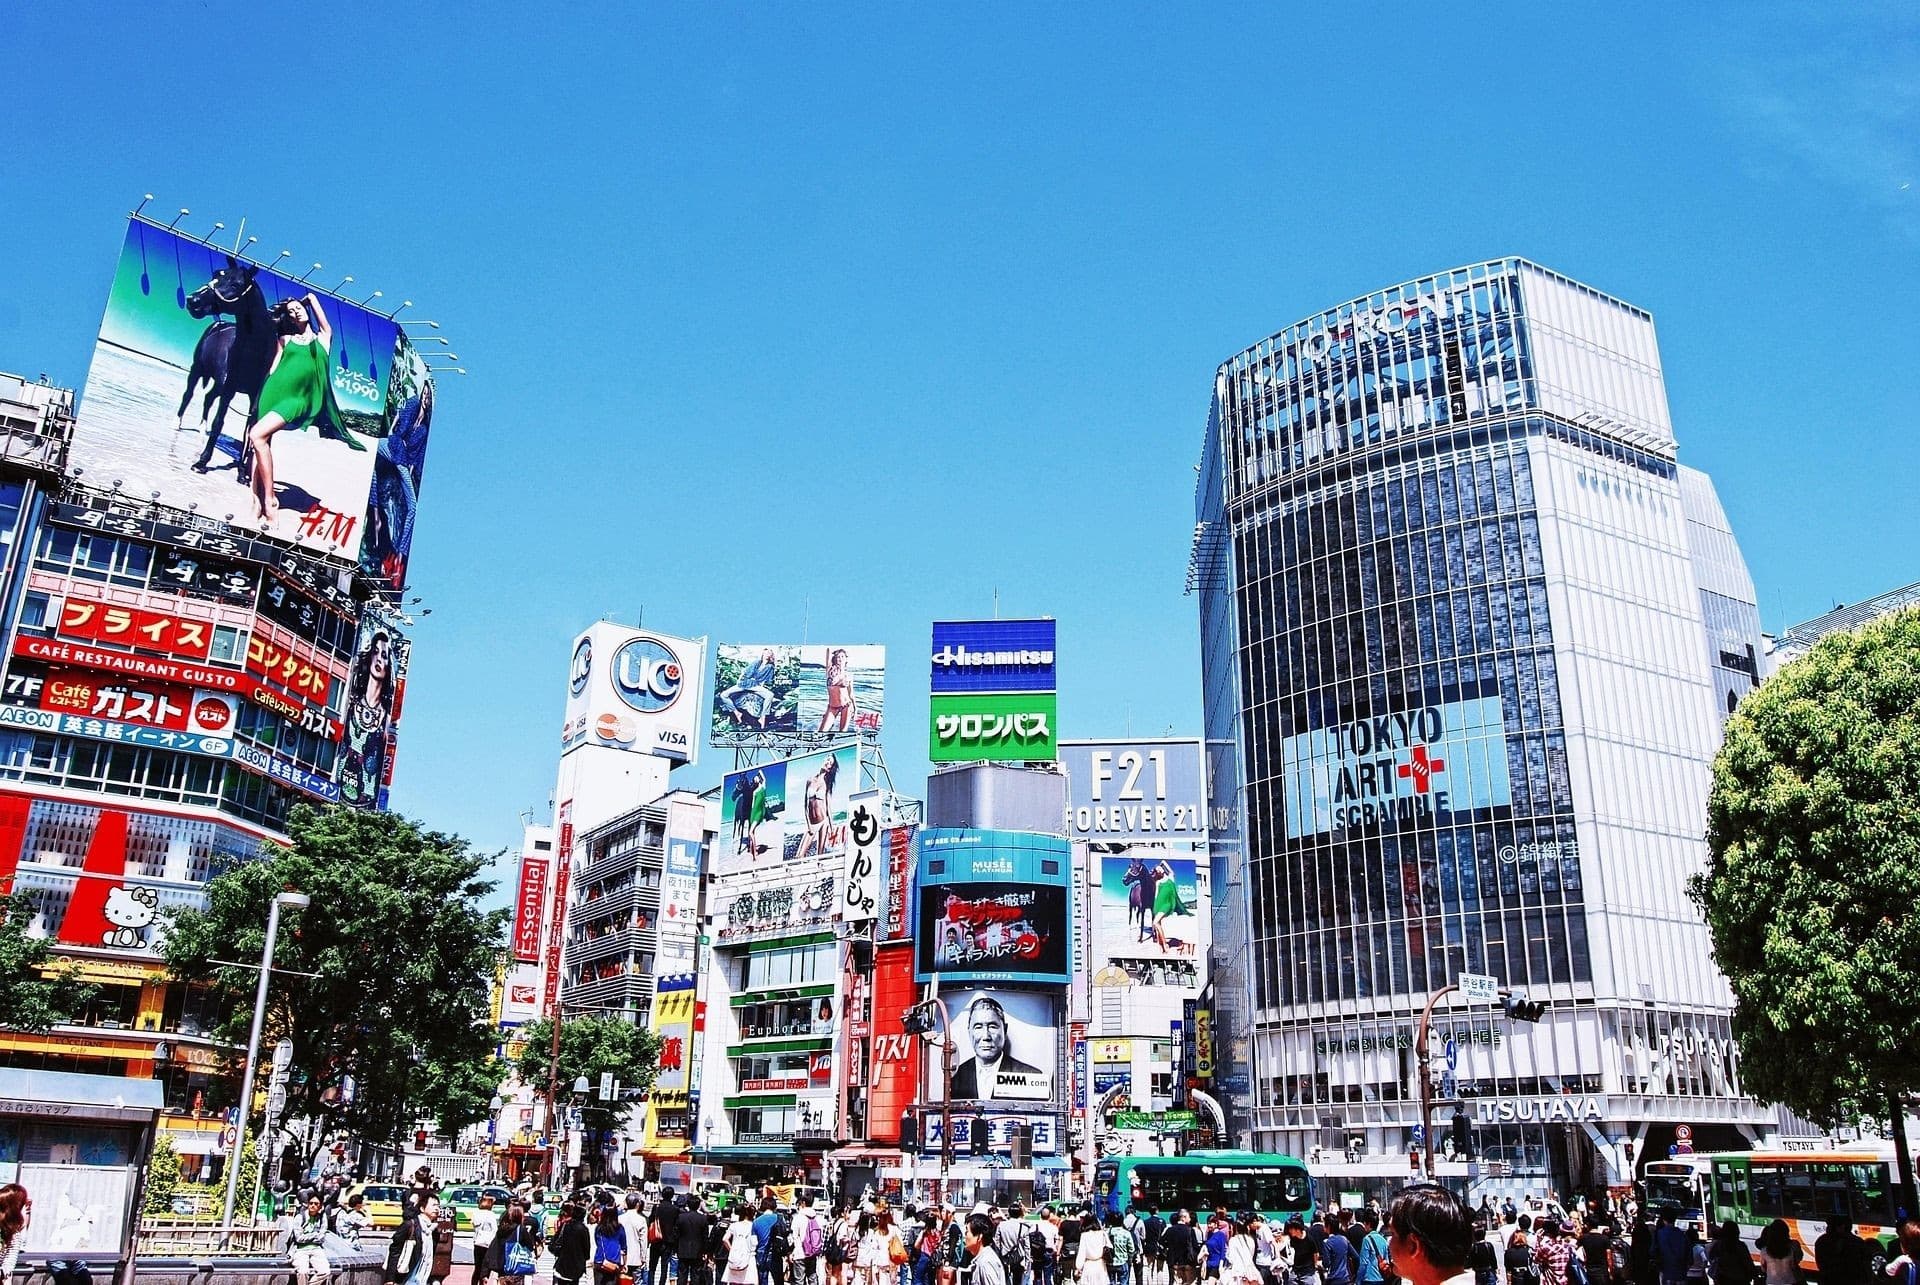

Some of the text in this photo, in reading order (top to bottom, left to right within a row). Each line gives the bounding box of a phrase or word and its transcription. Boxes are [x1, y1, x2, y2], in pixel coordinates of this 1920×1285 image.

[334, 375, 380, 401] ¥1,990
[297, 502, 357, 548] H&M
[168, 552, 181, 560] 9F
[64, 602, 205, 648] プライス
[29, 643, 236, 687] CAFÉ RESTAURANT GUSTO
[248, 637, 325, 694] コンタクト
[931, 645, 1054, 668] Hisamitsu
[7, 675, 43, 697] 7F
[50, 681, 91, 700] Café
[50, 696, 88, 709] レストラン
[91, 686, 182, 725] ガスト
[198, 710, 227, 722] ガスト
[1, 709, 223, 751] AEON 英会話イーオン 6F
[300, 708, 336, 739] ガスト
[936, 712, 1050, 740] サロンパス
[1331, 707, 1443, 760] TOKYO
[659, 731, 687, 745] VISA
[239, 745, 338, 797] AEON 英会話イーオン
[1091, 750, 1166, 801] F21
[1334, 757, 1397, 803] ART
[1174, 805, 1198, 831] 21
[1335, 791, 1449, 830] SCRAMBLE
[847, 805, 878, 915] もんじゃ
[972, 858, 1012, 868] MUSÉE
[515, 861, 540, 956] Essential
[1074, 926, 1083, 973] neon
[749, 1023, 808, 1036] Euphoria
[1317, 1034, 1416, 1055] STARBUCK
[812, 1054, 831, 1073] JTB
[0, 1101, 70, 1114] ふれあいマップ
[1481, 1098, 1603, 1121] TSUTAYA
